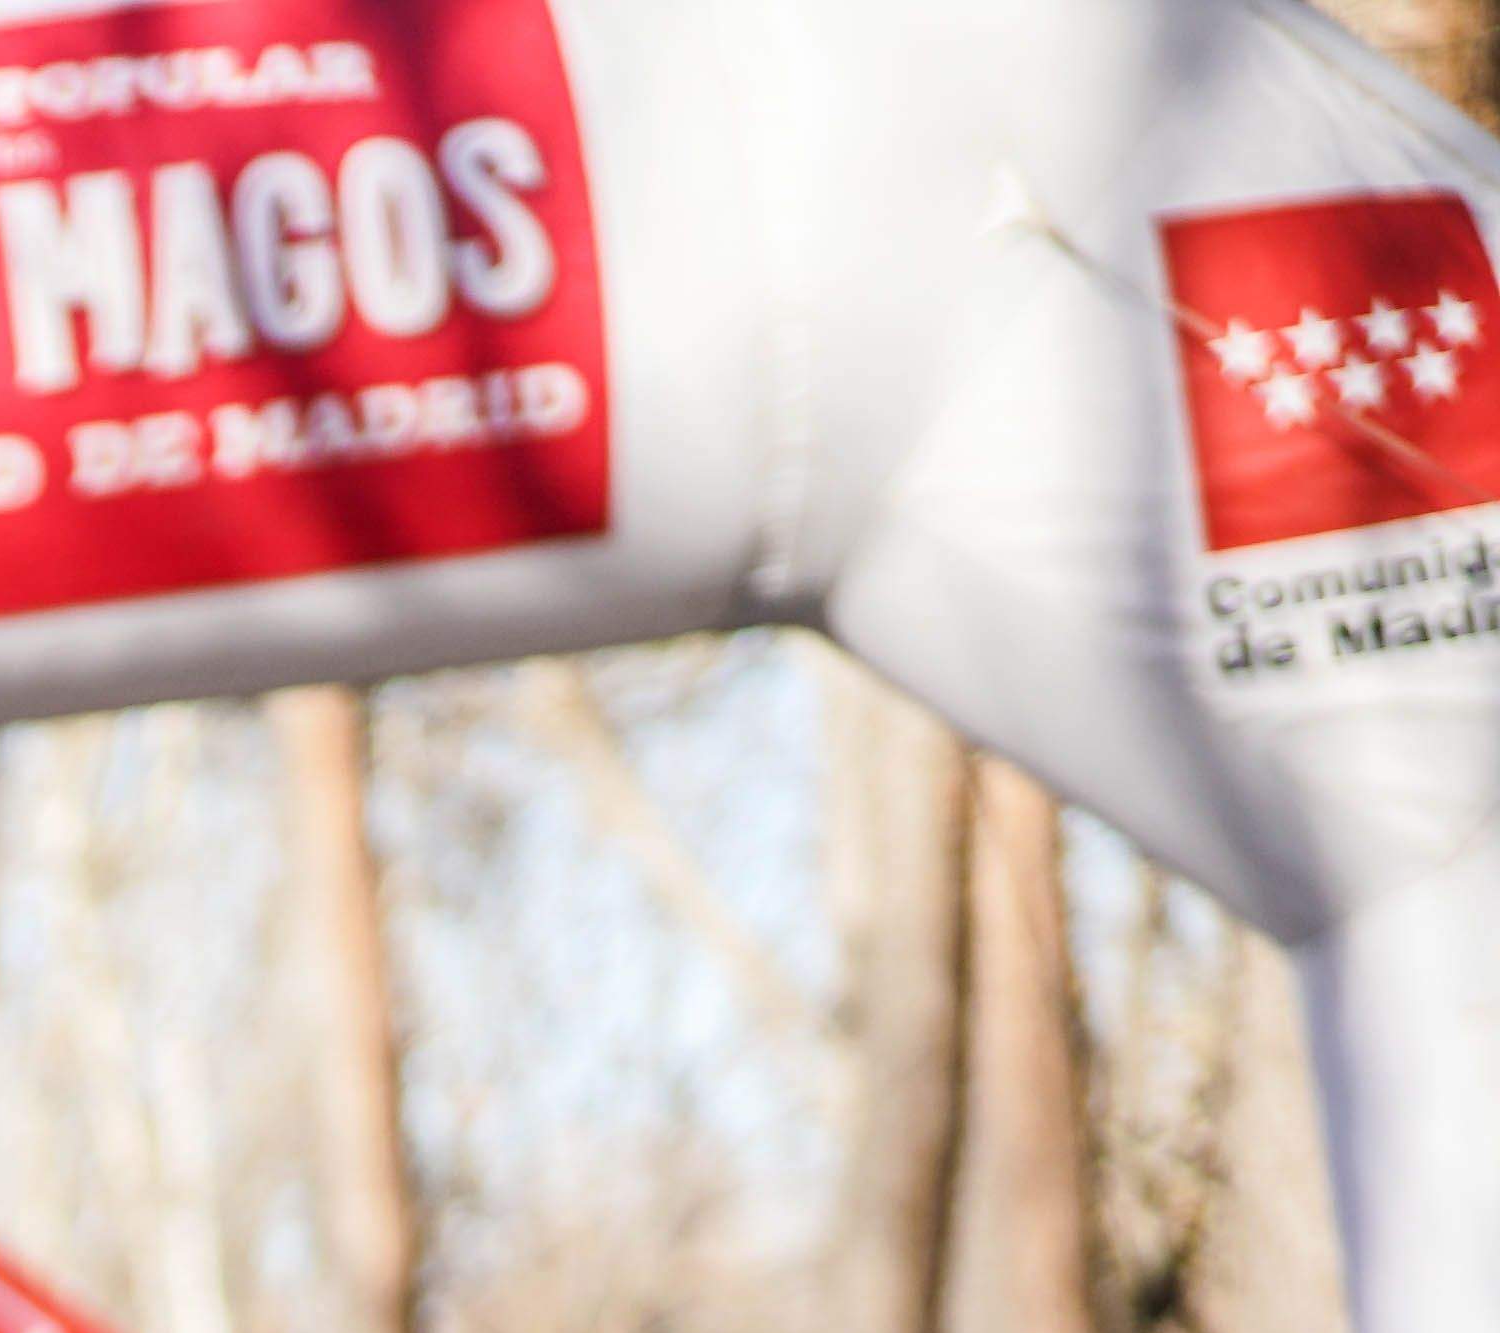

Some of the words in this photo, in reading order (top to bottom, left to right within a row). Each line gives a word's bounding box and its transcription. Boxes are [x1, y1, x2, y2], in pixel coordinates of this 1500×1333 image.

[68, 408, 203, 496] DE
[211, 363, 589, 482] MADRID
[1217, 623, 1296, 678] de
